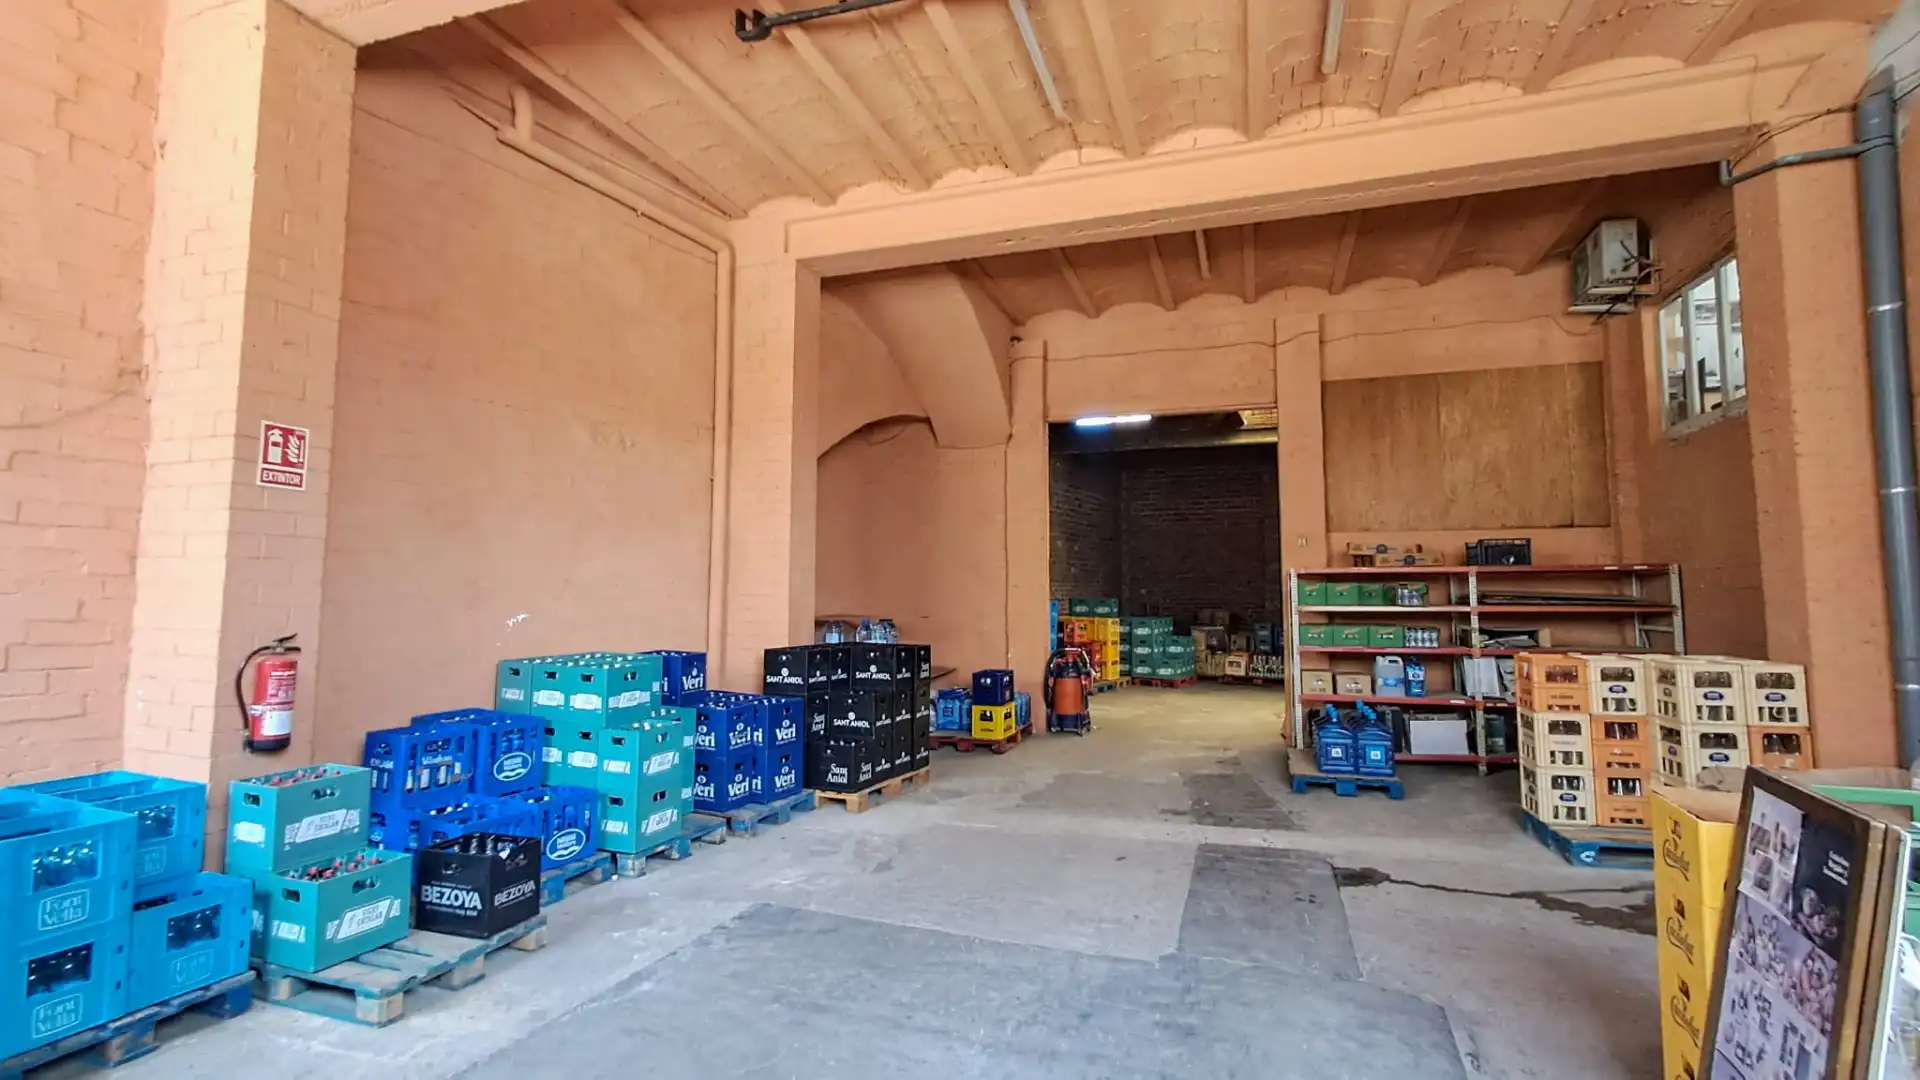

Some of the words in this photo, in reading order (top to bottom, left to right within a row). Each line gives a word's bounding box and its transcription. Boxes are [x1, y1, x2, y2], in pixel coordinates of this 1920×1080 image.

[263, 471, 301, 485] EXTINTOR
[682, 673, 704, 691] Veri
[766, 675, 783, 683] SANT
[783, 676, 804, 685] ANIOL
[855, 671, 871, 679] SANT
[871, 672, 891, 680] ANIOL
[775, 723, 796, 741] Veri
[833, 718, 850, 726] SANT
[850, 720, 870, 728] ANIOL
[728, 726, 751, 746] Veri
[727, 777, 750, 797] Veri
[774, 769, 795, 788] Veri
[421, 885, 482, 910] BEZOYA
[494, 880, 536, 906] BEZOYA
